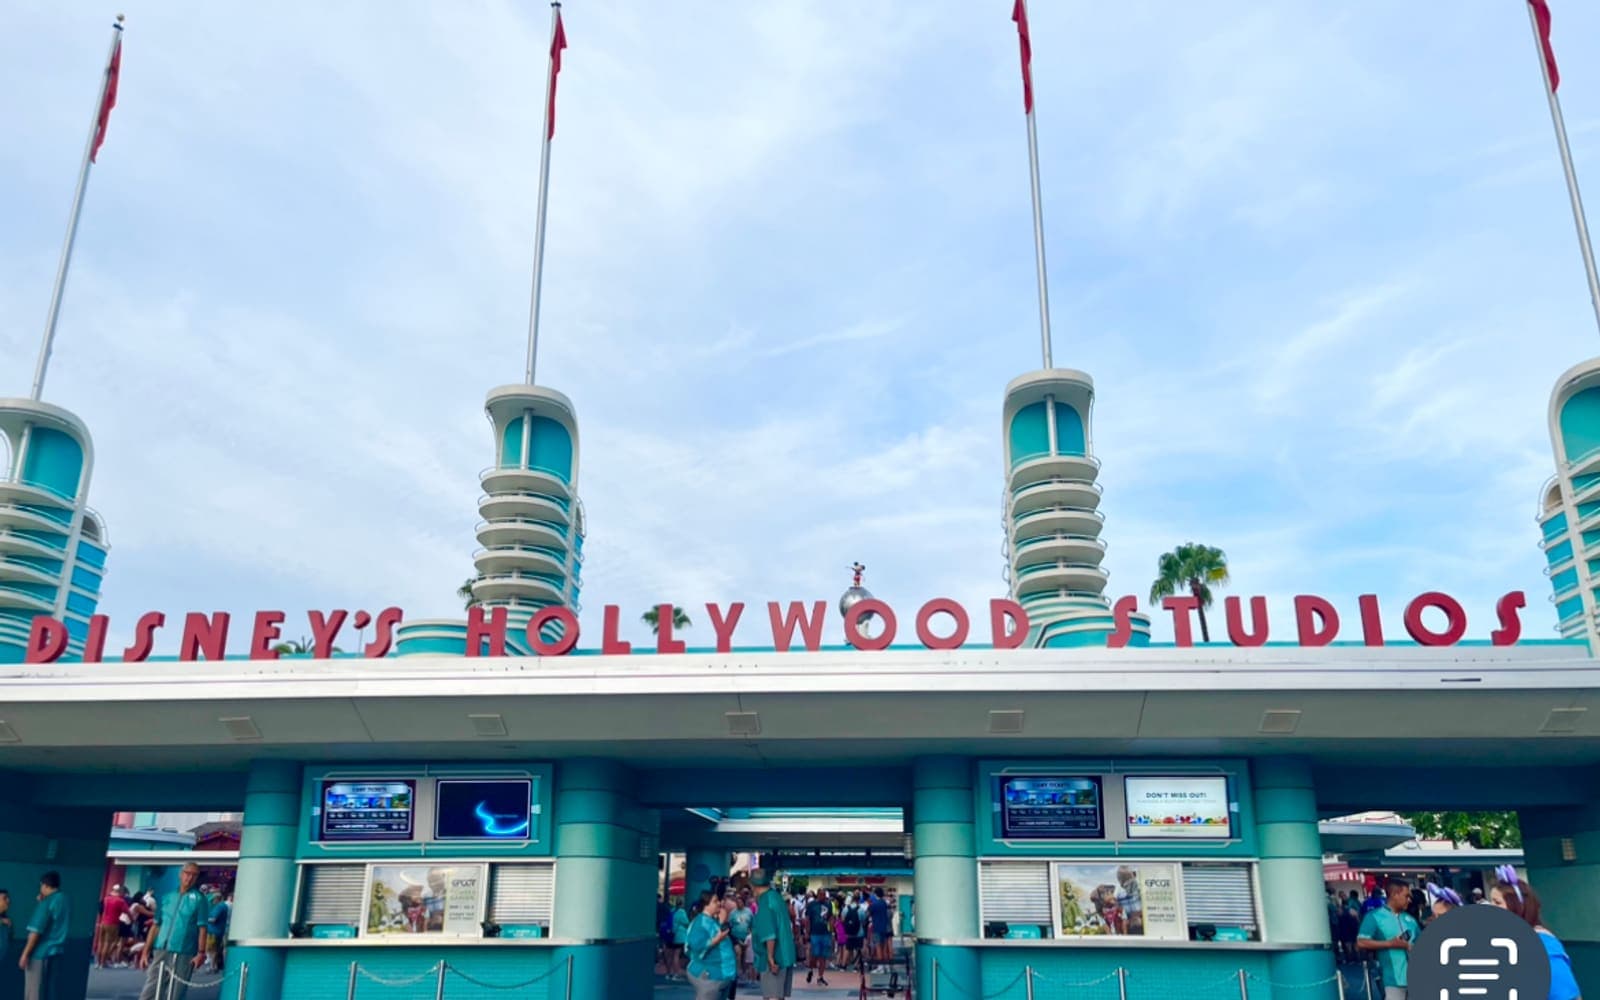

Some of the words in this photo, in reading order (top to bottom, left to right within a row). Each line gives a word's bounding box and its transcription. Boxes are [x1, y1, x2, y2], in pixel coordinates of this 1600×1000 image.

[24, 607, 403, 663] DISNEY'S
[464, 598, 1030, 657] HOLLYWOOD
[1106, 591, 1526, 647] STUDIOS
